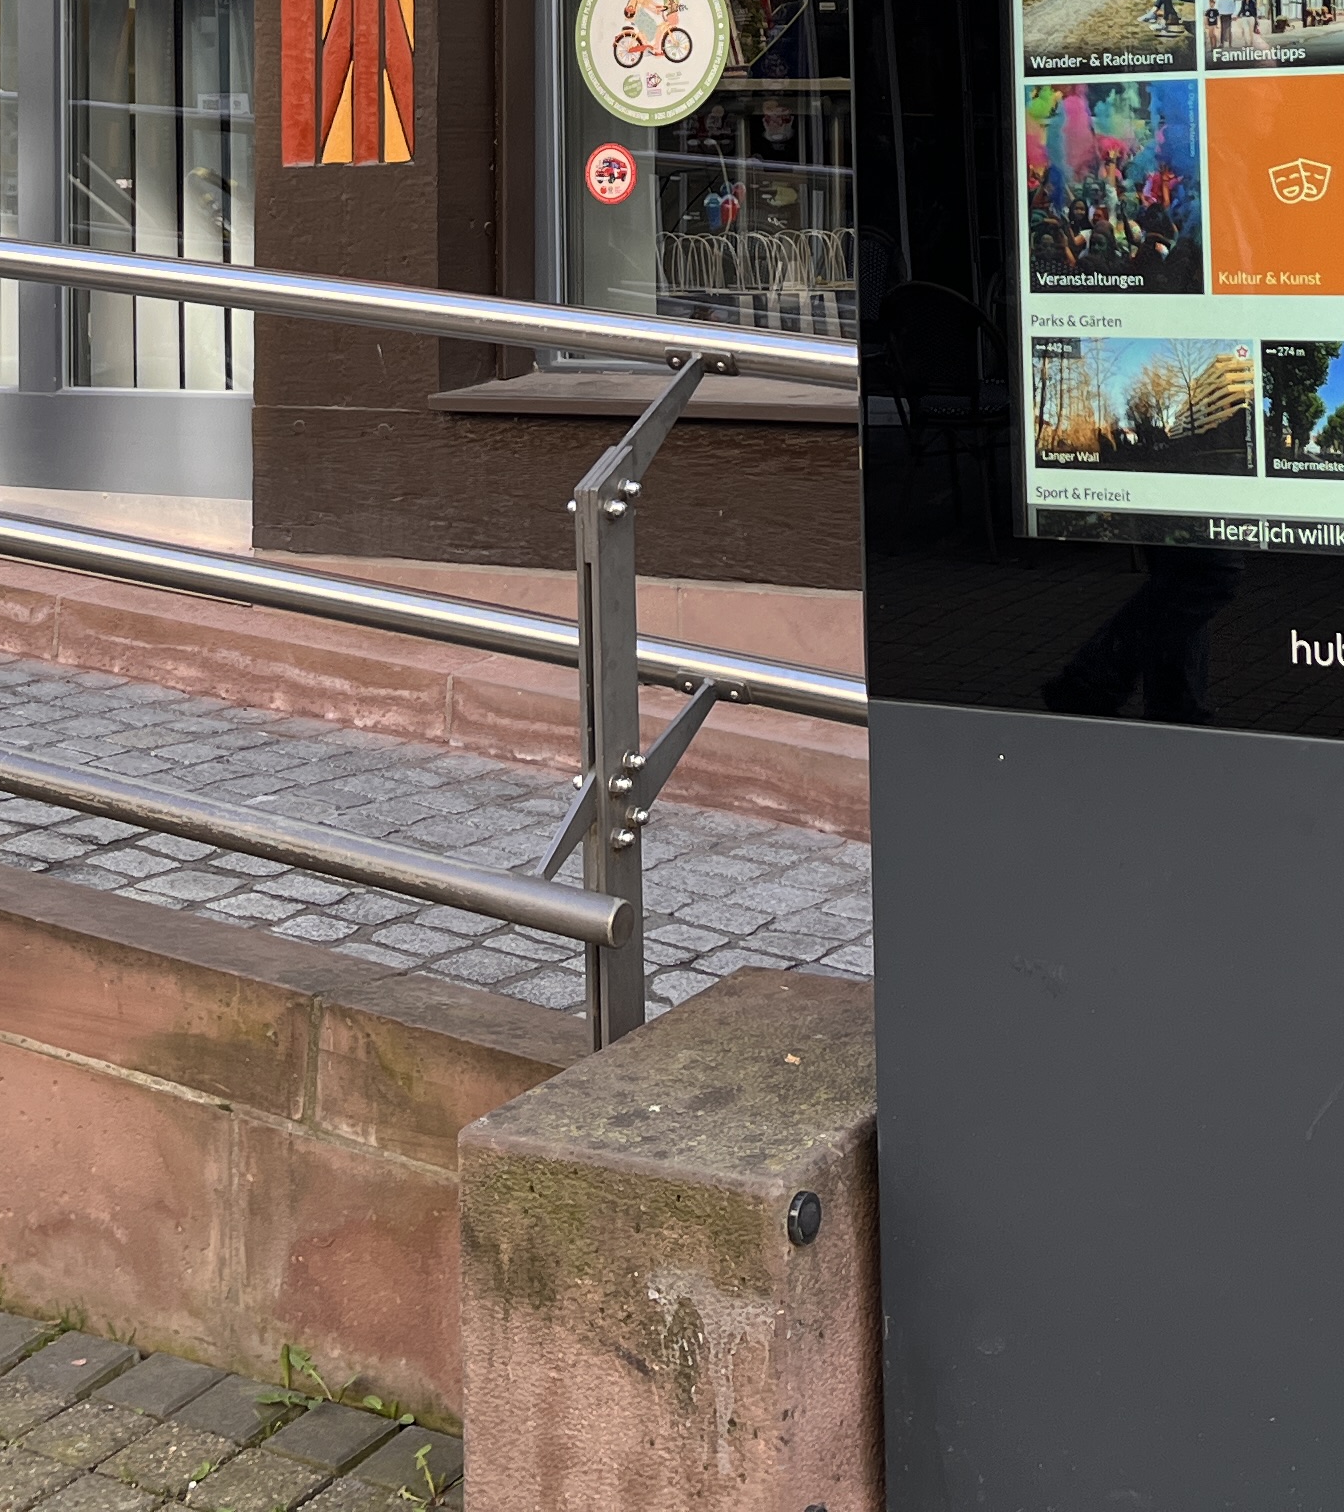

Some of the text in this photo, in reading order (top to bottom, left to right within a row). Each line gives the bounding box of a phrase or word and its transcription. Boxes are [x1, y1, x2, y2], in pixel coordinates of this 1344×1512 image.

[1030, 50, 1174, 70] Wander- & Radtouren
[1211, 46, 1307, 64] Familientipps
[1036, 271, 1145, 289] Veranstaltungen
[1218, 270, 1322, 286] Kultur & Kunst
[1030, 313, 1123, 329] Parks & Gärten
[1277, 345, 1295, 357] 274
[1041, 450, 1101, 465] Langer Wall
[1035, 486, 1132, 503] Sport & Freizeit
[1208, 517, 1296, 546] Herzlich
